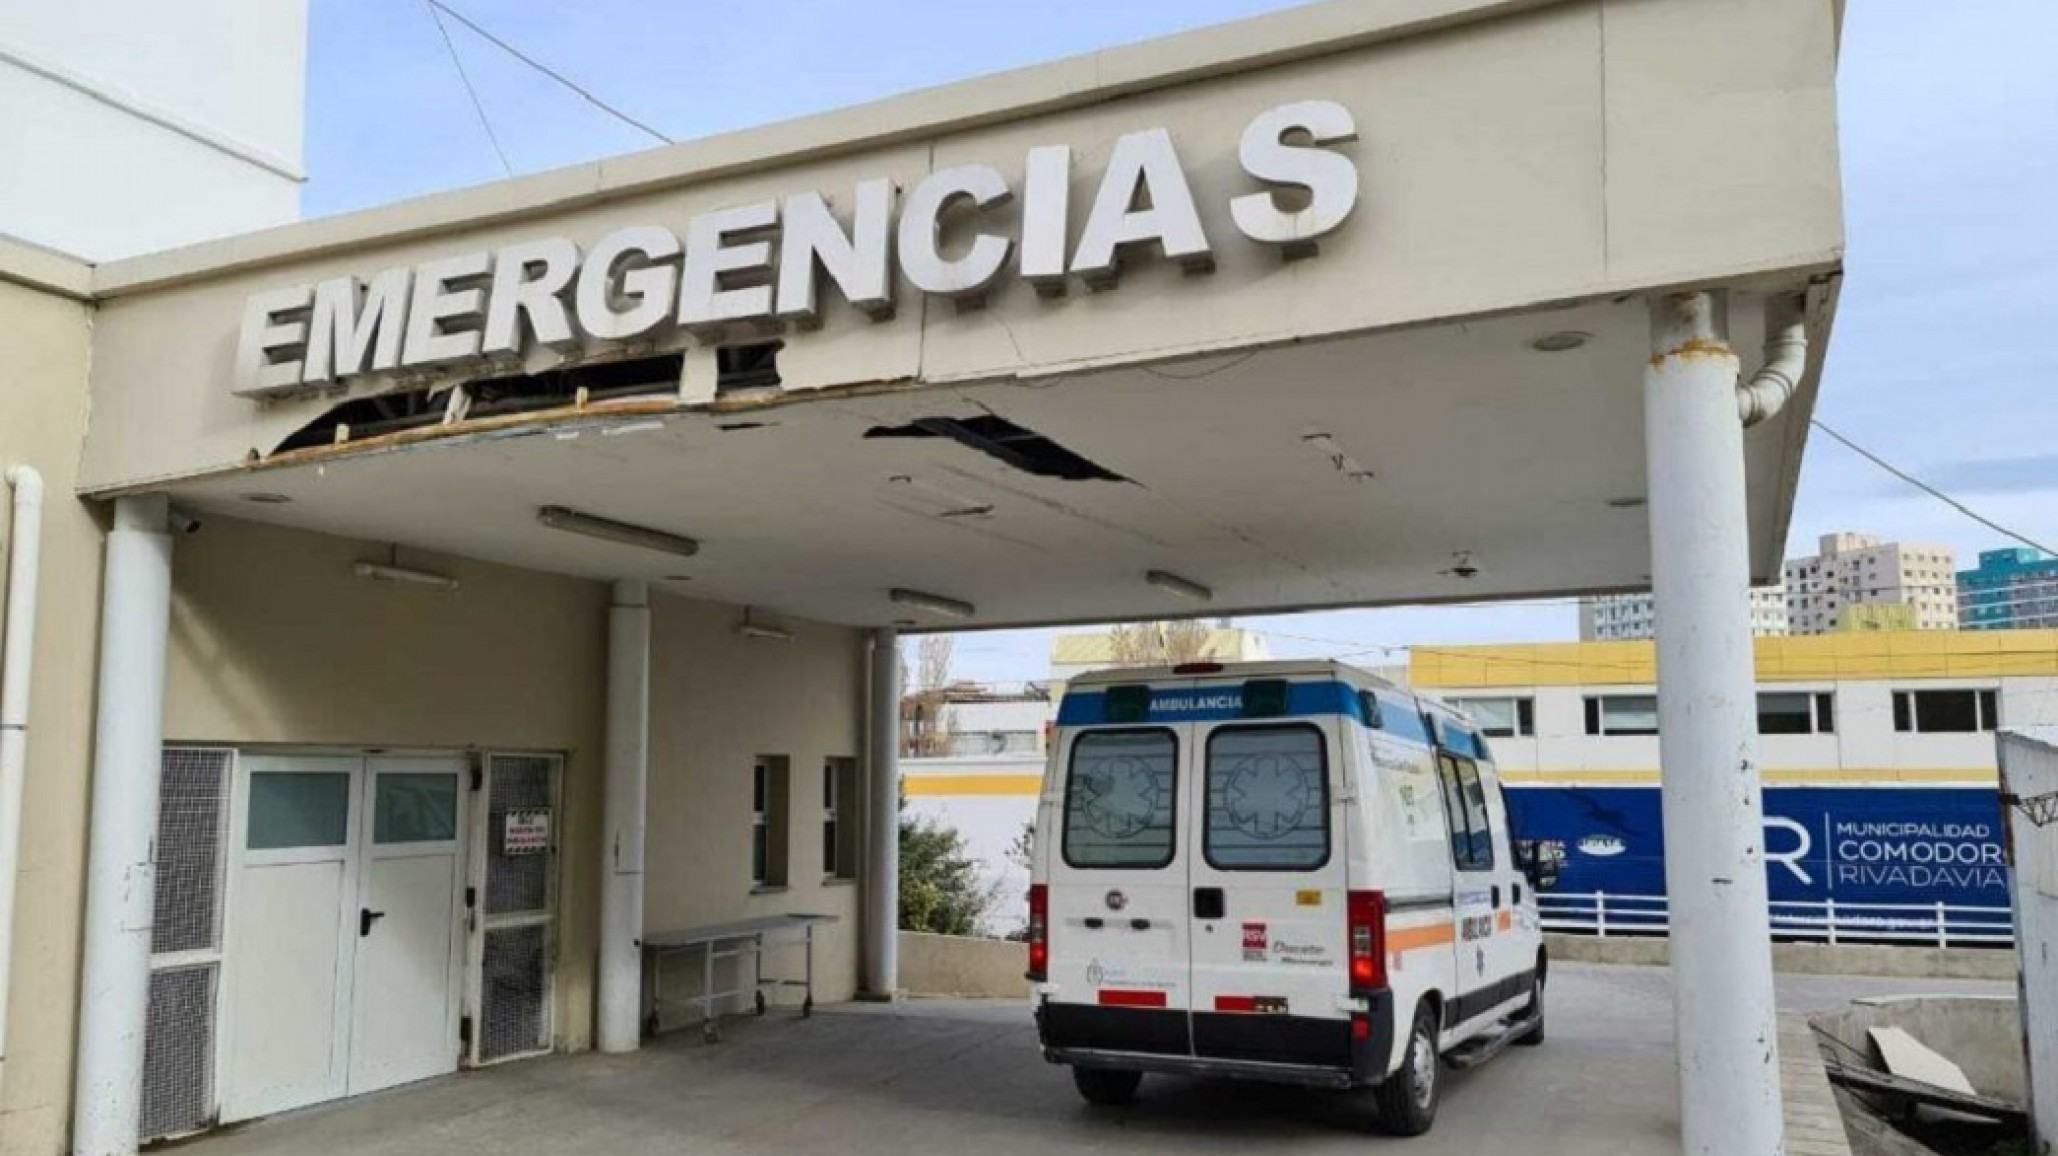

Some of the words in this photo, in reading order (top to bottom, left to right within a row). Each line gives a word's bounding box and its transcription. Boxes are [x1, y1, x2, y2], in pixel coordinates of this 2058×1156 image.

[234, 100, 1358, 392] EMERGENCIAS
[1148, 696, 1244, 711] AMBULANCIA
[1836, 822, 1990, 838] MUNICIPALIDAD
[1838, 840, 2007, 865] COMODOR
[1838, 865, 2007, 888] RIVADAVIA
